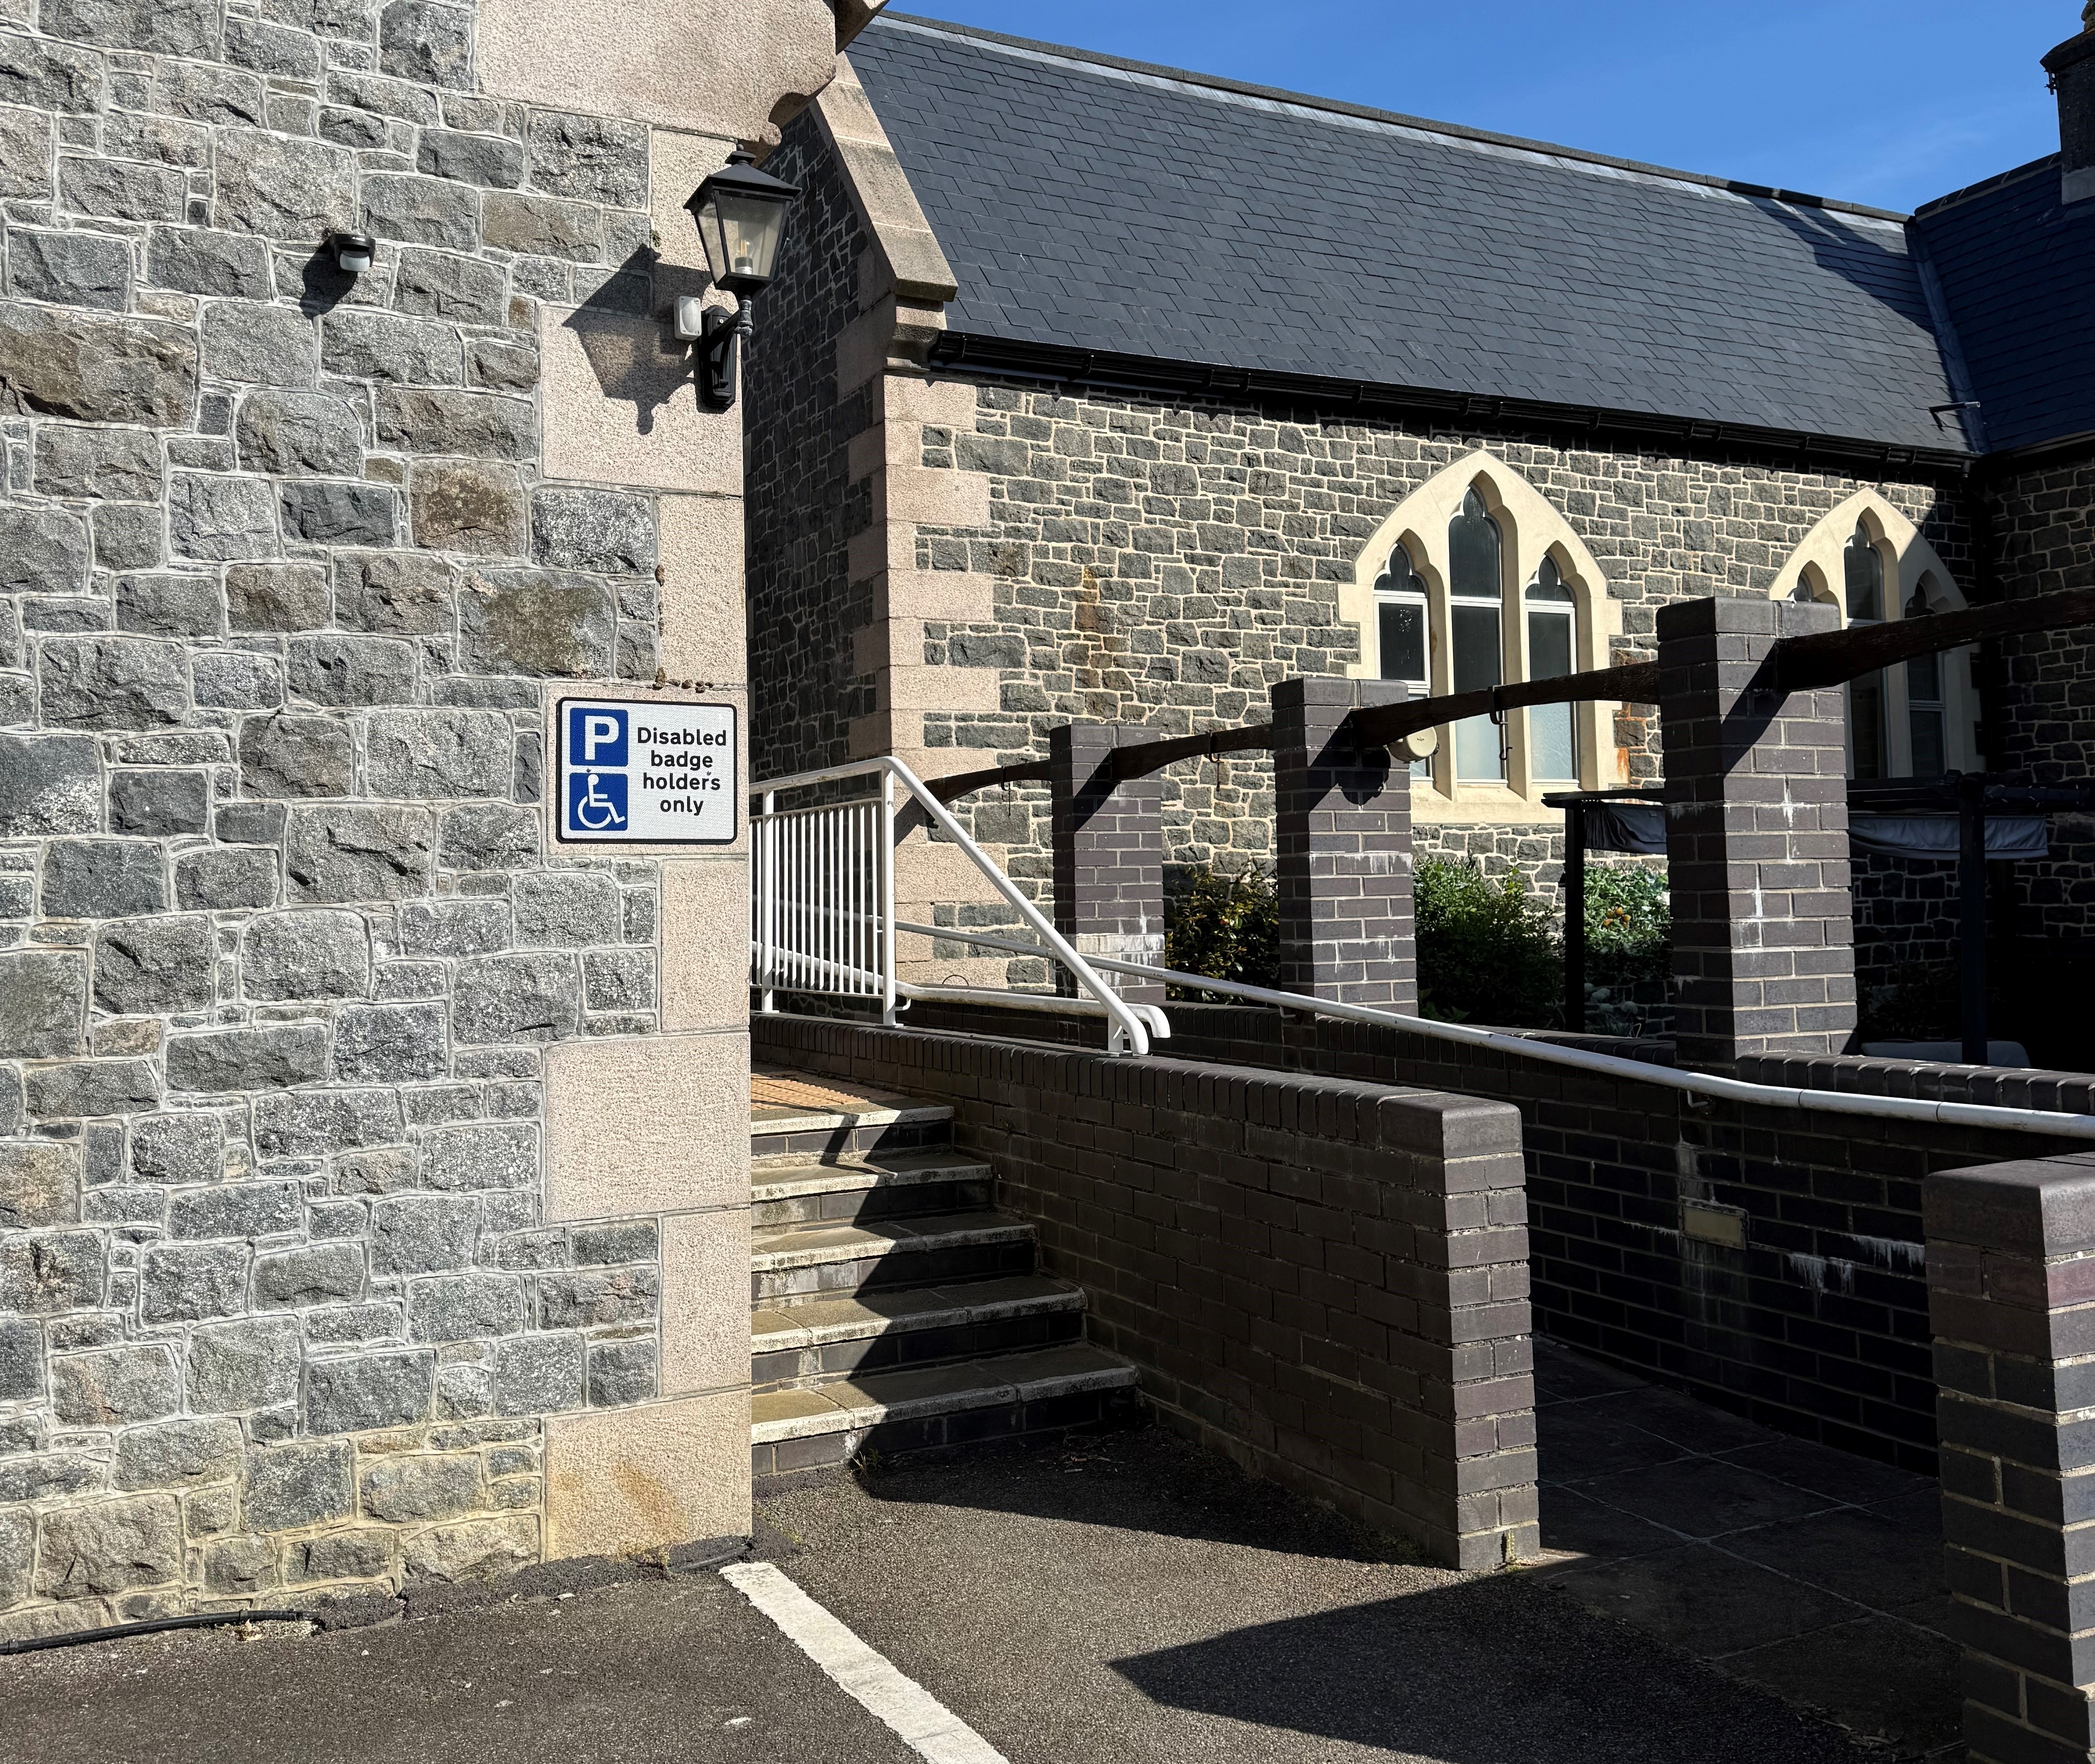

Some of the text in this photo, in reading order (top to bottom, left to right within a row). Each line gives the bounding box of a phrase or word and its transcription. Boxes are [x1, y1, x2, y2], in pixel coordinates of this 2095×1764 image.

[584, 715, 619, 760] P
[637, 727, 727, 746] Disabled
[651, 750, 713, 770] badge
[660, 796, 704, 816] only
